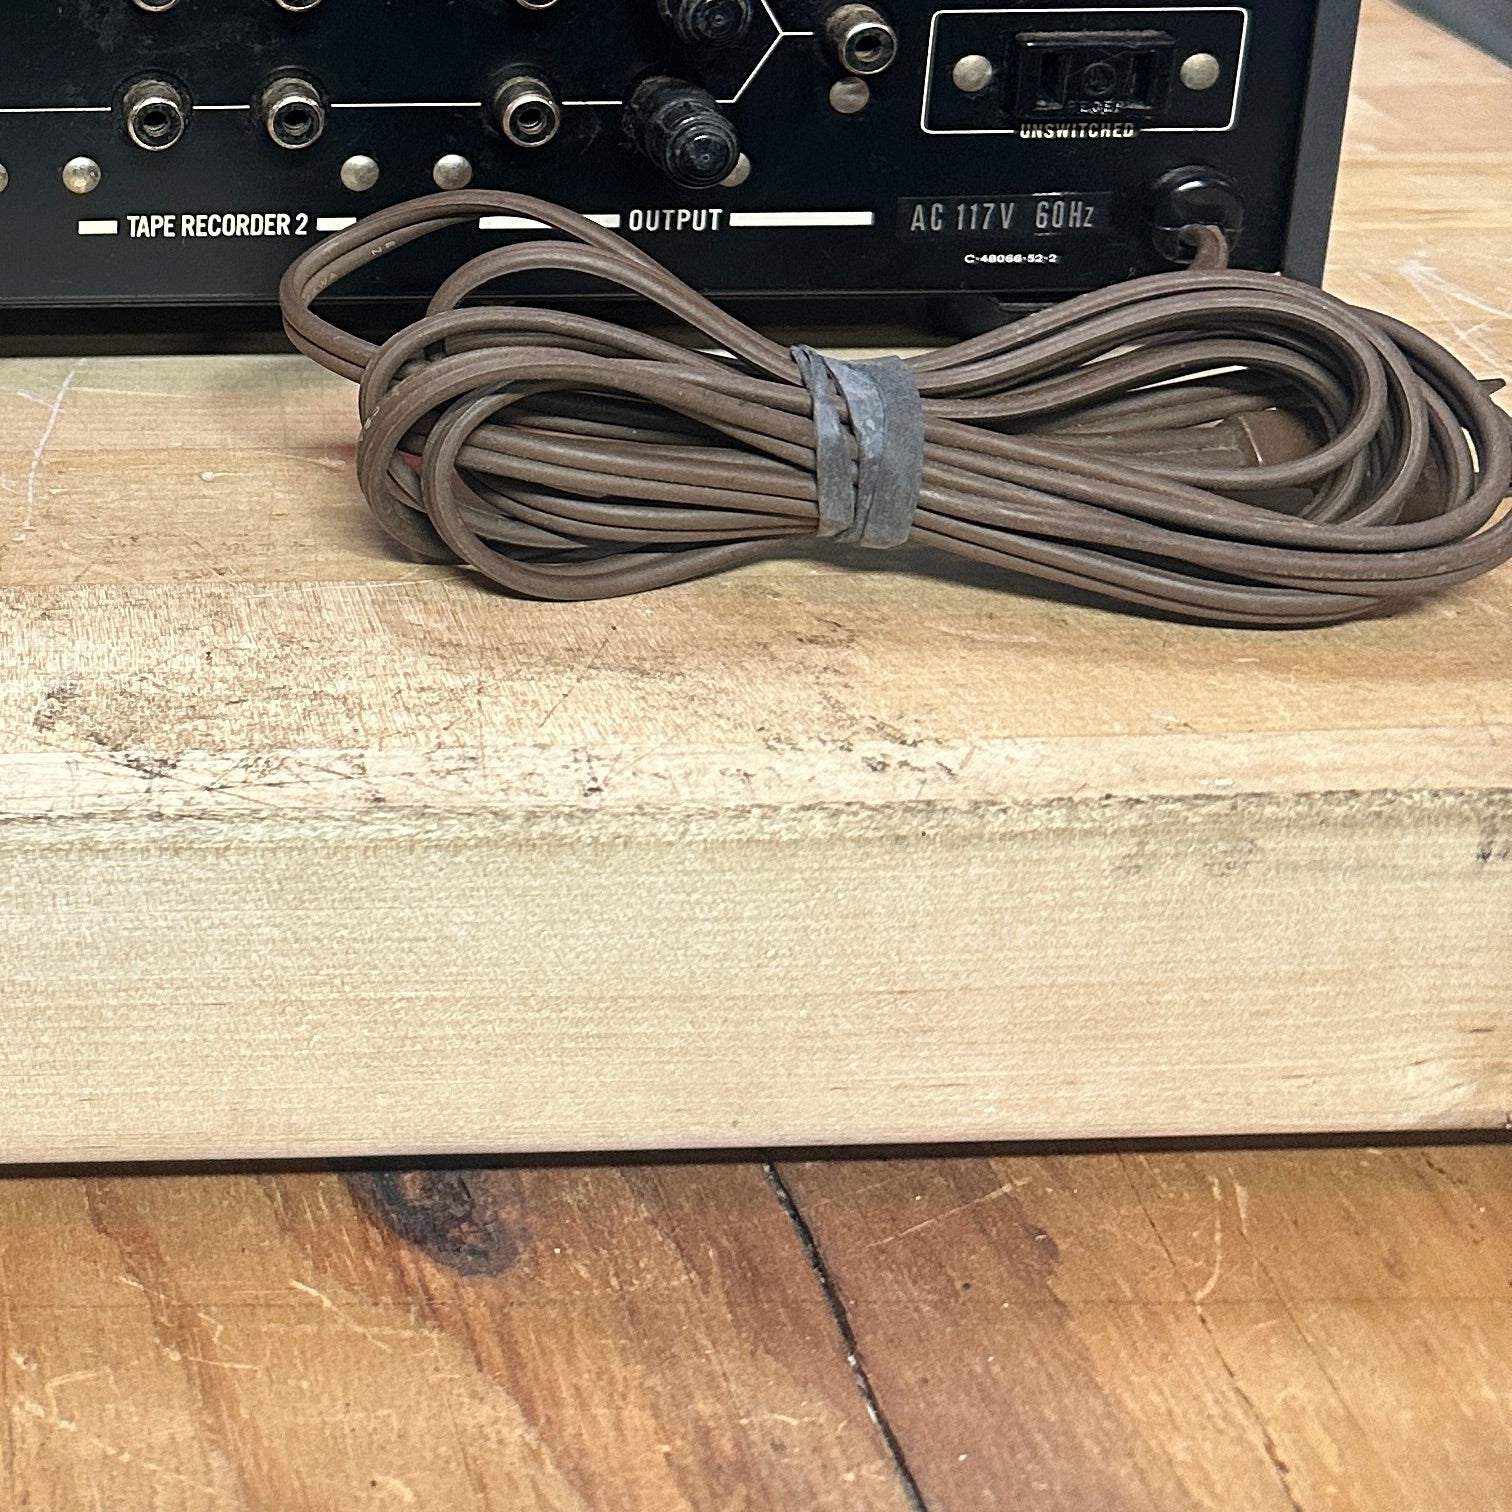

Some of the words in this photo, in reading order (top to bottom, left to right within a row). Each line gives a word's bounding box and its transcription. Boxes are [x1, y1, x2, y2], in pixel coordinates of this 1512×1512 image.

[1019, 123, 1135, 140] UNSWITCHED
[126, 214, 176, 238] TAPE
[181, 213, 291, 237] RECORDER
[294, 212, 309, 236] 2
[628, 208, 723, 232] OUTPUT
[910, 202, 944, 231] AC
[957, 202, 1015, 231] 117V
[1035, 200, 1094, 229] 60Hz
